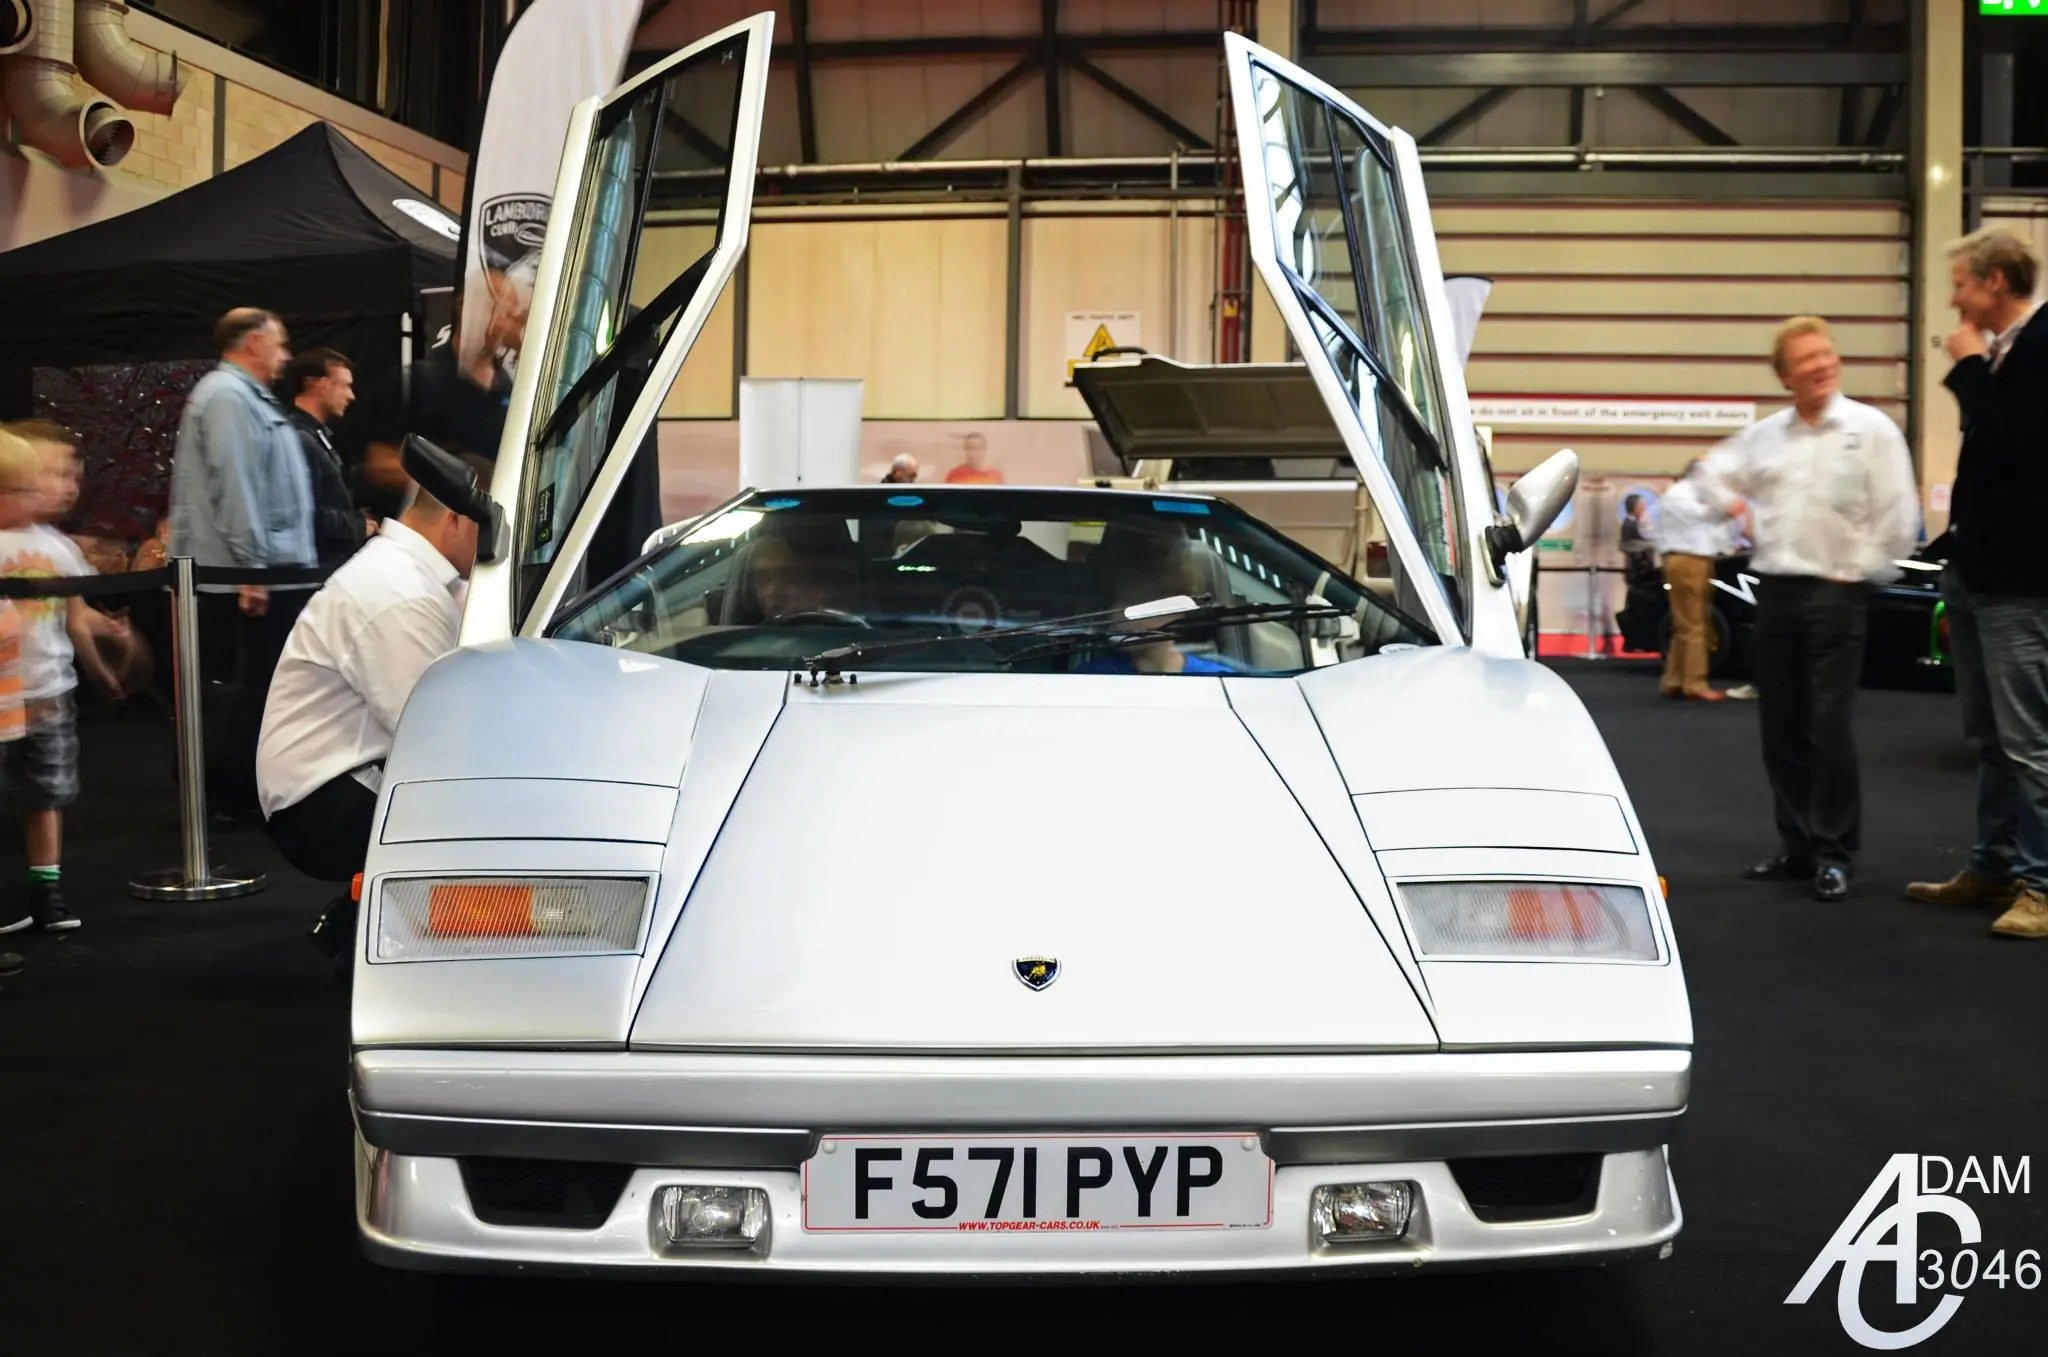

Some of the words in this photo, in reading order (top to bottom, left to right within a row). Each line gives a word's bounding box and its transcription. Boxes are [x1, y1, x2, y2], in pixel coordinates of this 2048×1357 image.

[485, 201, 549, 226] LAMBOR
[854, 1146, 1039, 1220] F571
[1066, 1145, 1223, 1219] PYP
[958, 1220, 1101, 1231] WWW.TOPGEAR-CARS.CO.UK
